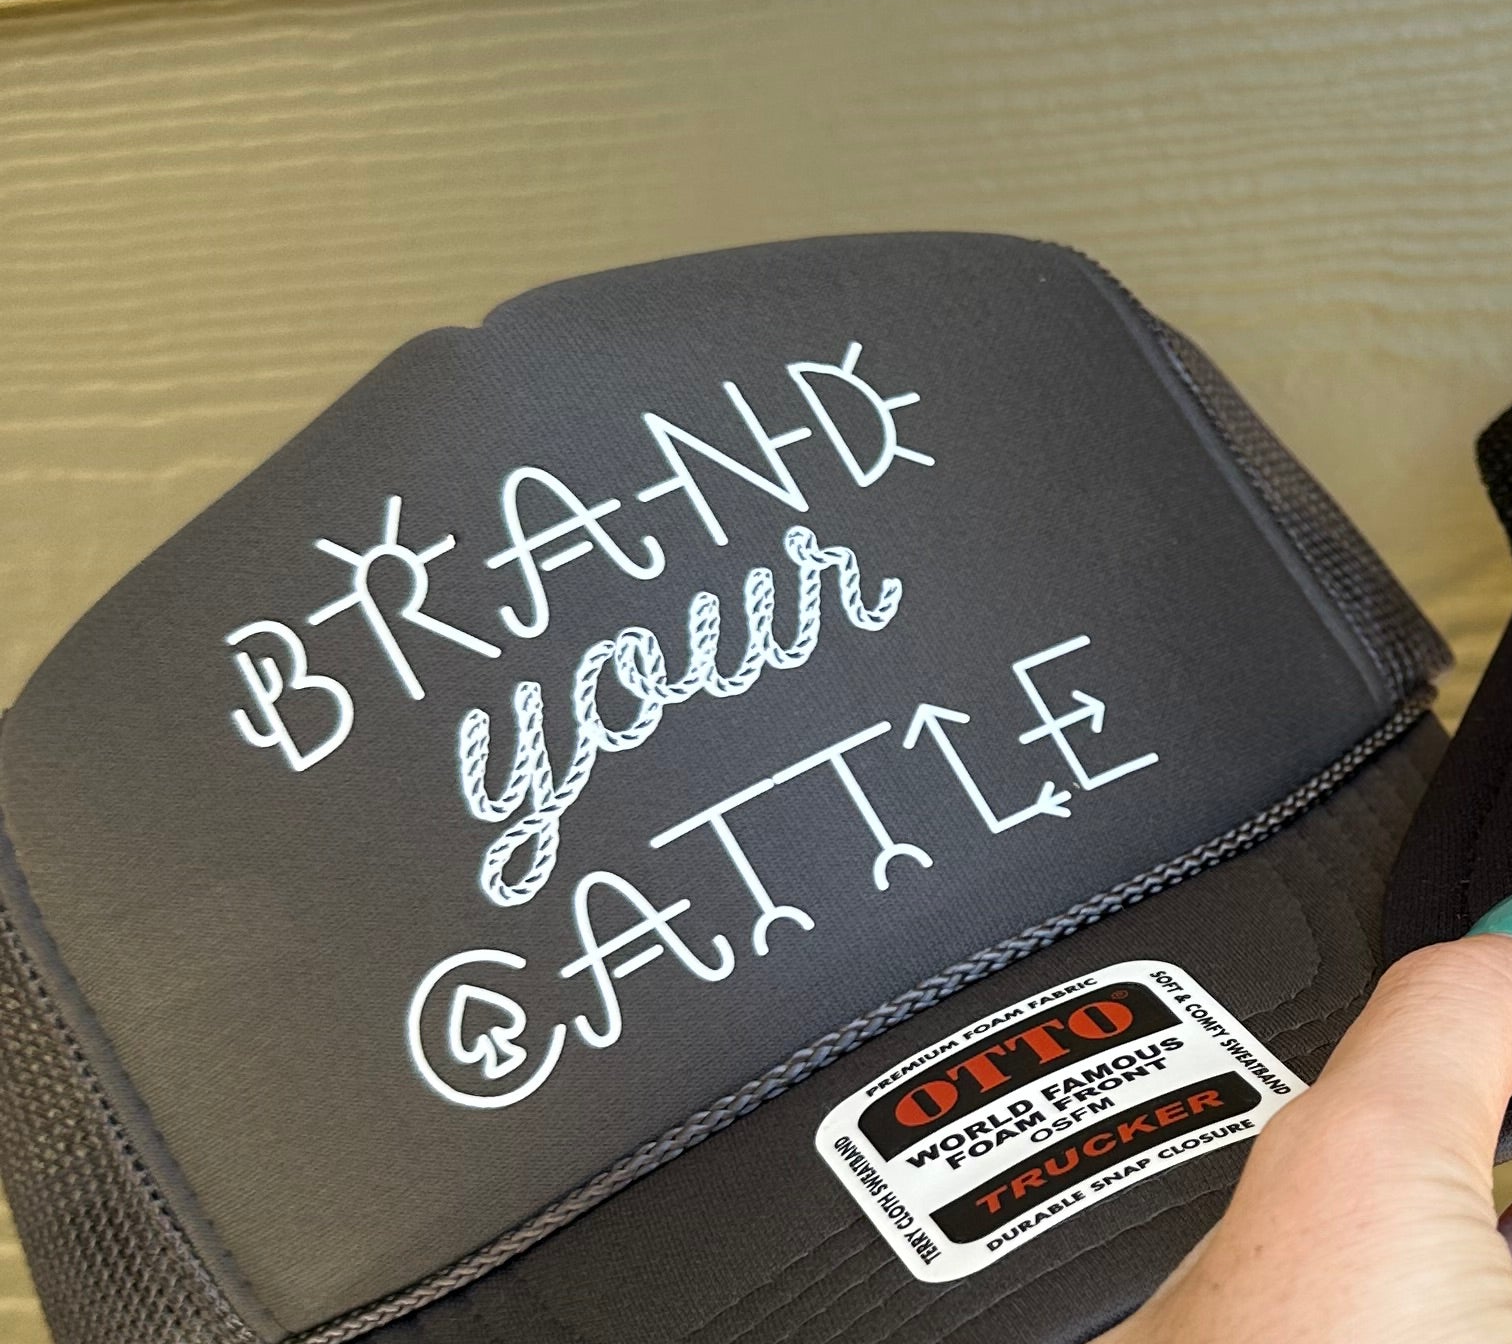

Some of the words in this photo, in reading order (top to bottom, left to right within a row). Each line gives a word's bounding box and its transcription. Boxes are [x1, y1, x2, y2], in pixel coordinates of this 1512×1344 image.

[226, 341, 935, 773] BRAND
[457, 526, 903, 908] your
[407, 634, 1160, 1111] CATTLE
[865, 1040, 959, 1097] PREMIUM
[963, 1008, 1025, 1040] FOAM
[1028, 978, 1098, 1009] FABRIC
[1150, 970, 1184, 993] SOFT
[1174, 994, 1192, 1004] &
[1185, 1004, 1230, 1038] COMFY
[1220, 1038, 1291, 1096] SWEATBAND
[906, 1099, 1034, 1168] WORLD
[1041, 1037, 1185, 1102] FAMOUS
[946, 1110, 1047, 1170] FOAM
[1052, 1057, 1168, 1112] FRONT
[976, 1089, 1224, 1214] TRUCKER
[1030, 1096, 1116, 1143] OSFM
[834, 1136, 889, 1197] SWEATBAND
[878, 1191, 914, 1229] CLOTH
[986, 1190, 1086, 1252] DURABLE
[1090, 1158, 1151, 1192] SNAP
[1157, 1118, 1256, 1159] CLOSURE
[904, 1227, 942, 1265] TERRY
